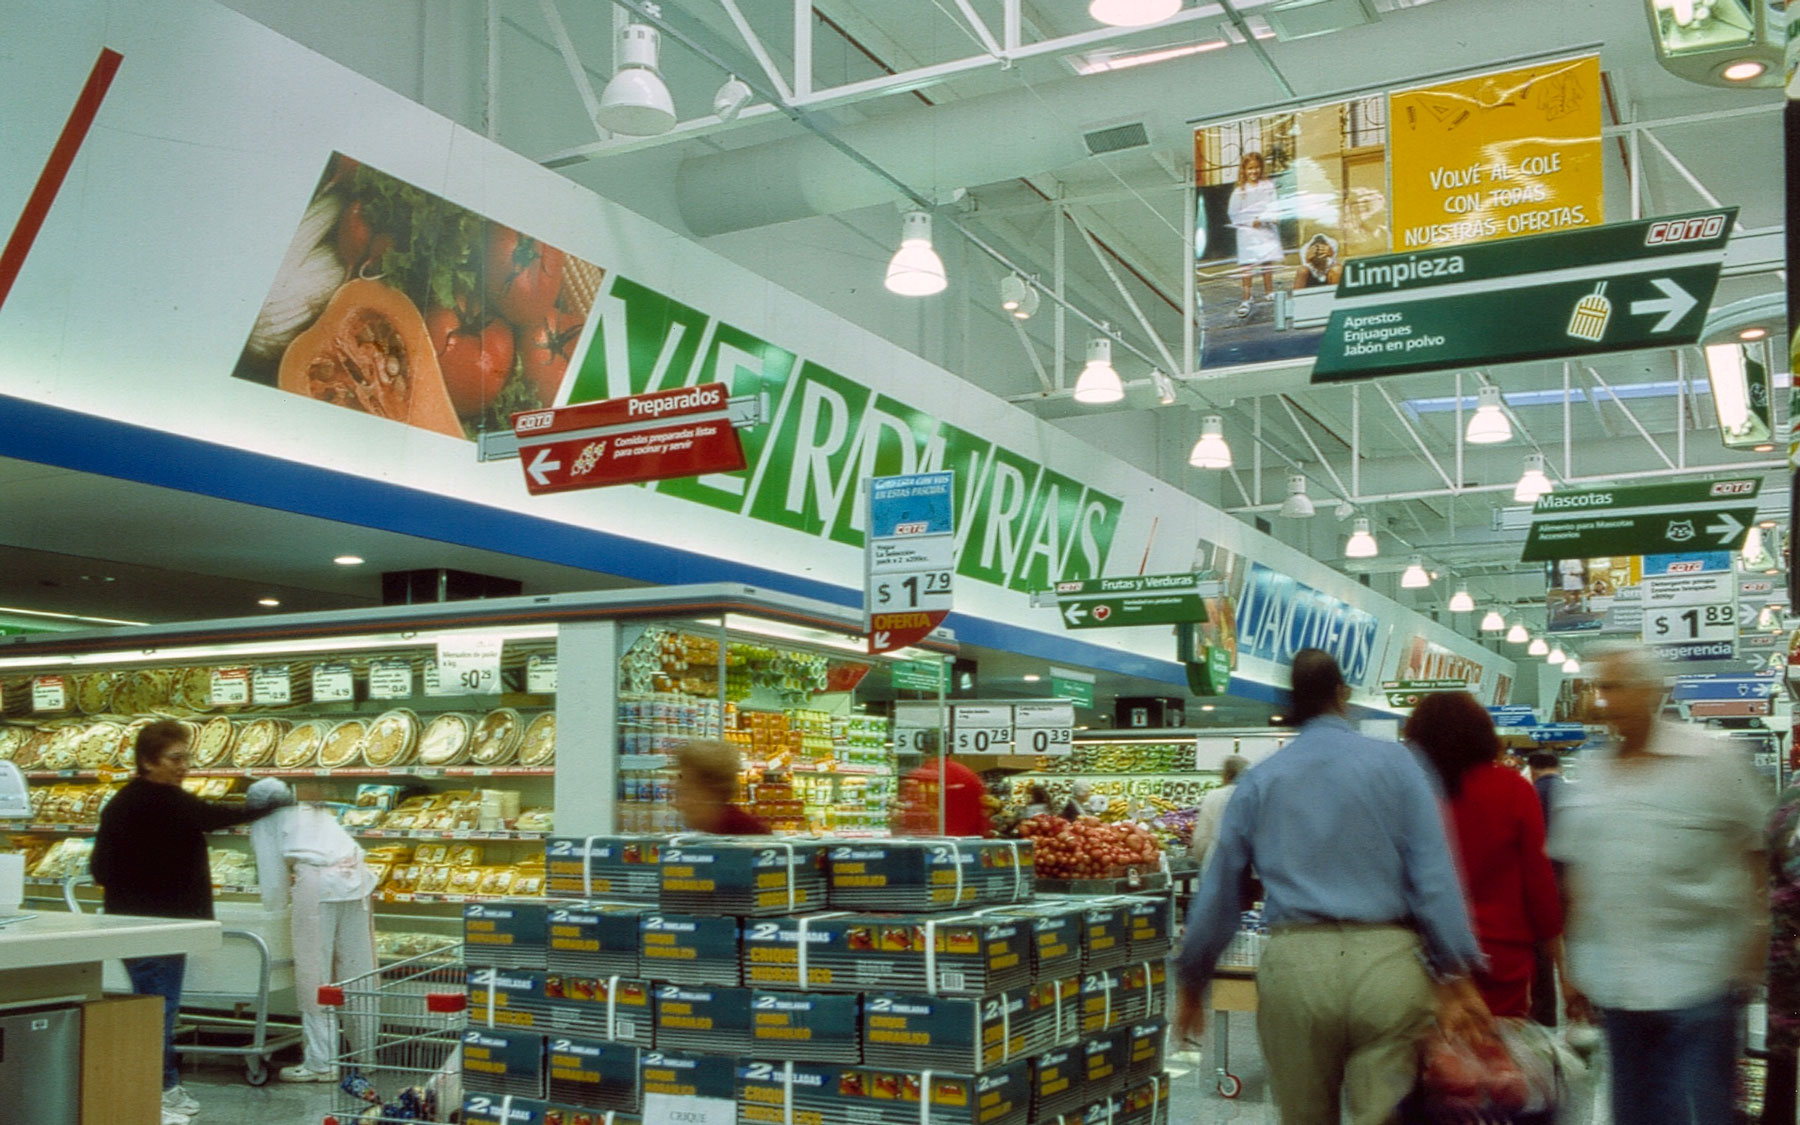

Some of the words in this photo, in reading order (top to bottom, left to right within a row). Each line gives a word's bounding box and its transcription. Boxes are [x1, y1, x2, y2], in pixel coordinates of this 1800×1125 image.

[1429, 163, 1481, 191] VOLVÉ
[1490, 163, 1512, 182] AL
[1520, 152, 1561, 176] COLE
[1444, 192, 1481, 214] CON
[1491, 184, 1547, 207] TODAS
[1405, 217, 1497, 247] NUESTRAS
[1507, 205, 1590, 234] OFERTAS.
[1645, 214, 1727, 247] COTO
[1345, 256, 1465, 288] Limpieza
[1343, 312, 1403, 329] Aprestos
[1344, 325, 1412, 343] Enjuagues
[1343, 341, 1384, 357] Jabón
[1386, 341, 1403, 352] en
[1406, 335, 1445, 351] polvo
[628, 387, 720, 417] Preparados
[514, 410, 556, 432] COTO
[614, 435, 648, 447] Comidas
[648, 430, 694, 445] preparadas
[613, 447, 633, 460] para
[1710, 480, 1756, 496] COTO
[1538, 492, 1613, 509] Mascotas
[1102, 579, 1134, 590] Frutas
[1135, 580, 1143, 590] y
[1145, 575, 1193, 588] Verduras
[878, 584, 892, 603] $
[874, 613, 931, 631] OFERTA
[1655, 616, 1669, 635] $
[750, 922, 780, 941] 2
[756, 996, 777, 1009] 2
[871, 998, 893, 1011] 2
[745, 1062, 774, 1080] 2
